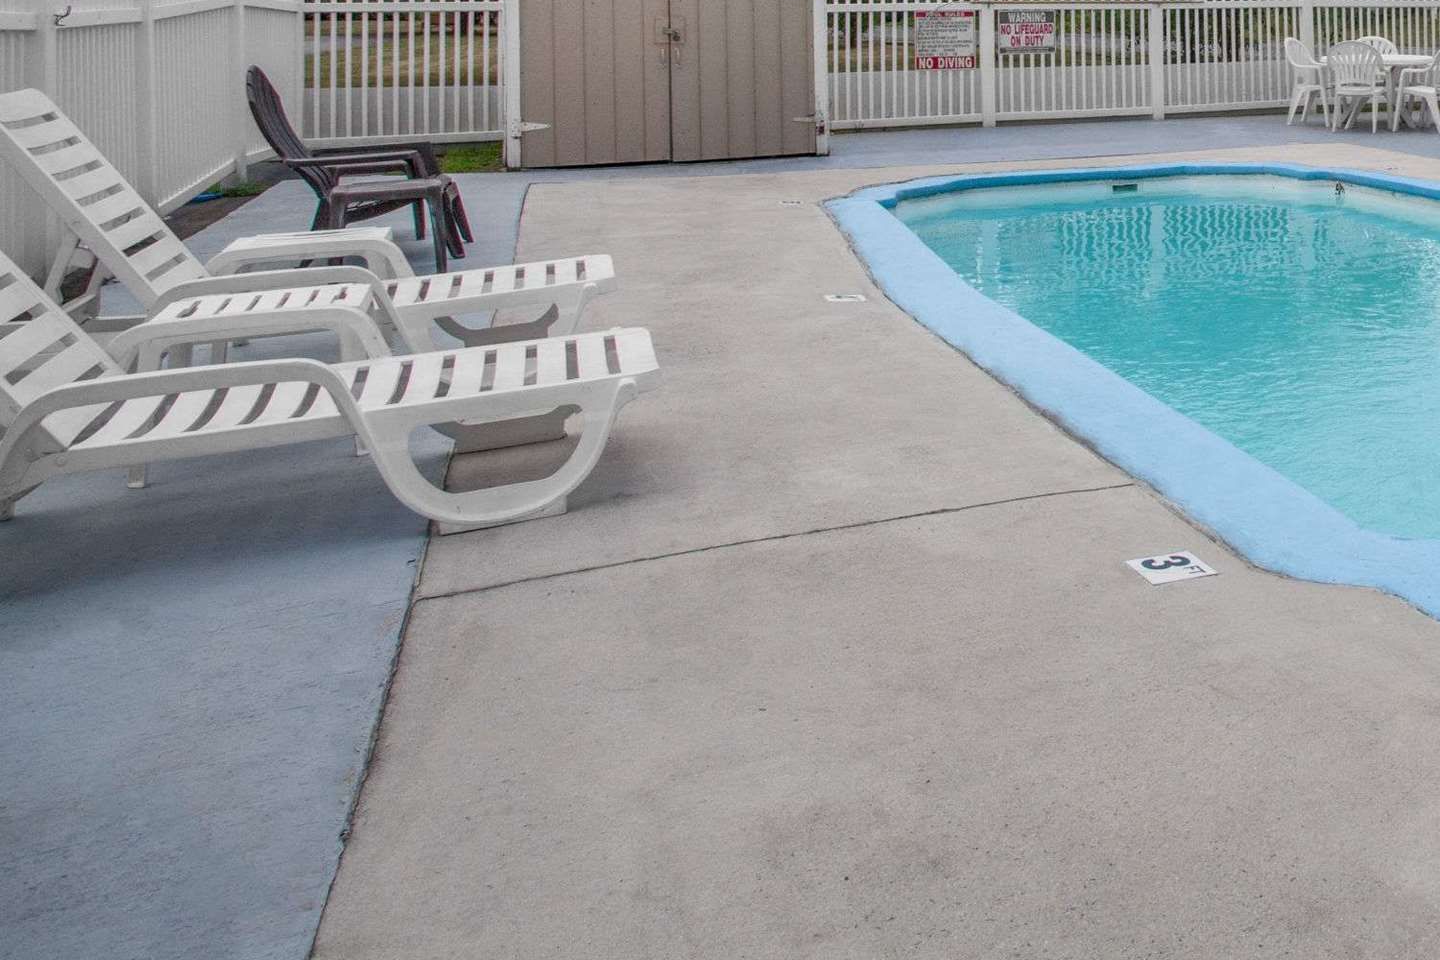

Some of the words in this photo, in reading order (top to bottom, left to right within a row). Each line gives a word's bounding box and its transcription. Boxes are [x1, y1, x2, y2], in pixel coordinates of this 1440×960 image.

[1008, 12, 1047, 23] WARNING
[1000, 24, 1011, 35] NO
[1014, 23, 1054, 35] LIFEGUARD
[1010, 35, 1021, 47] ON
[1024, 35, 1045, 46] DUTY
[919, 57, 933, 69] NO
[937, 56, 973, 69] DIVING
[1141, 555, 1191, 570] 3
